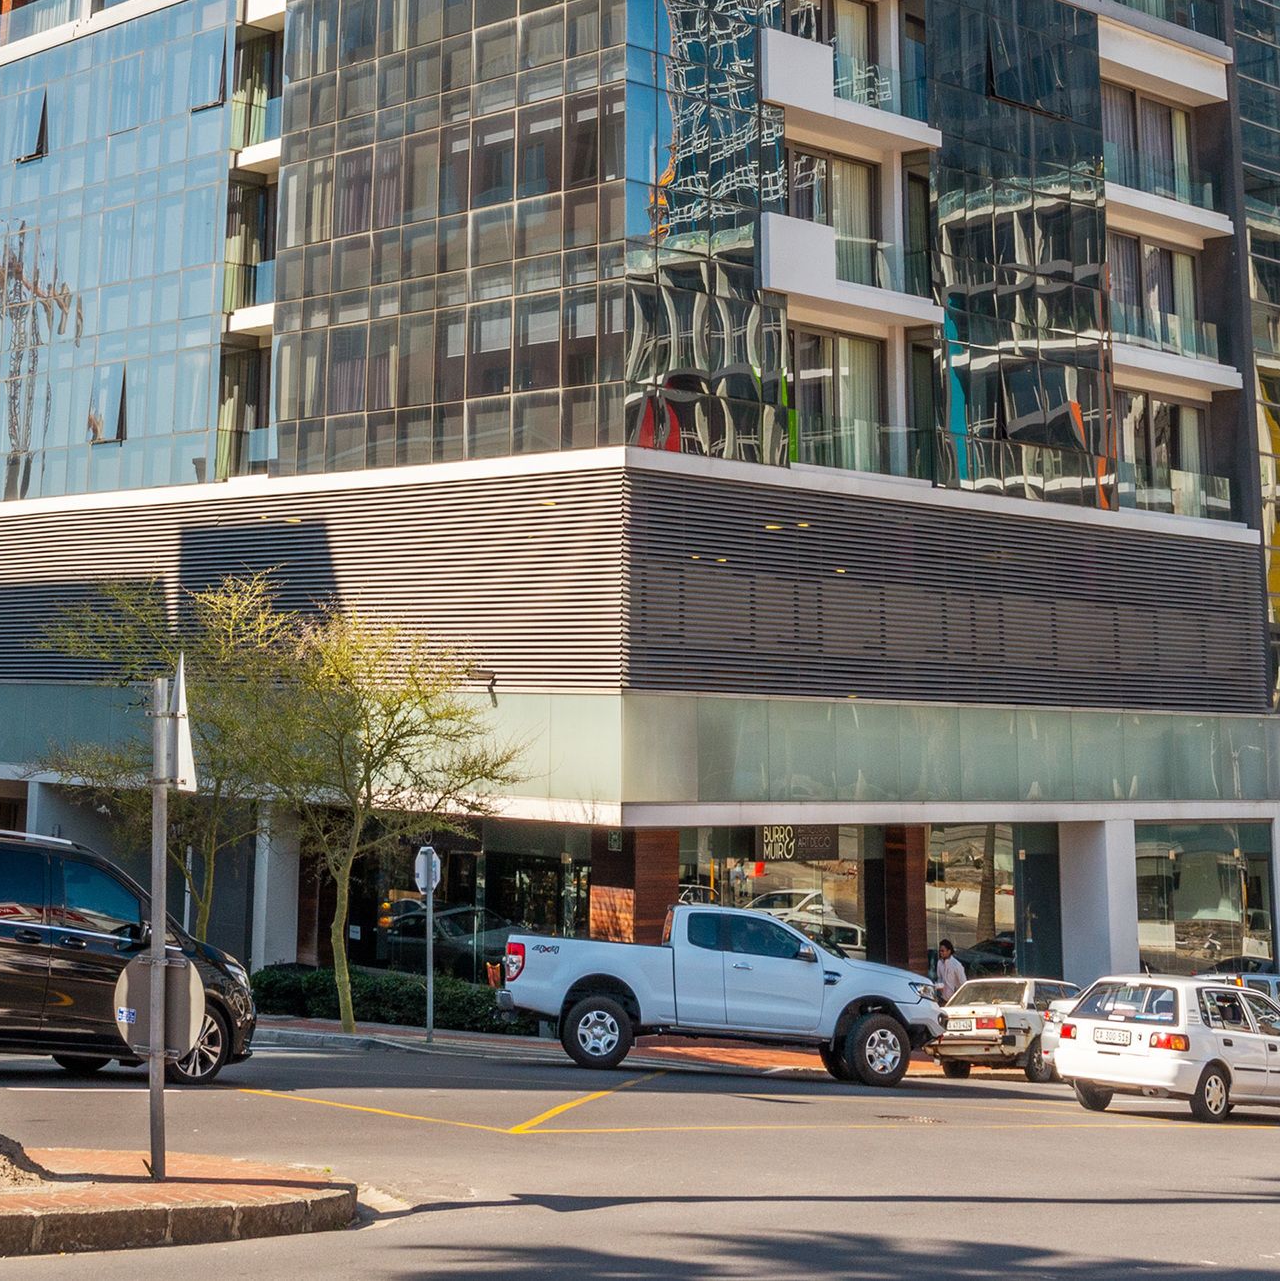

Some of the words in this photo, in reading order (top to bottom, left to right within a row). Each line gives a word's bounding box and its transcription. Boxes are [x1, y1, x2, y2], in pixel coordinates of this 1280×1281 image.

[763, 826, 785, 843] BURR
[784, 825, 796, 859] &
[763, 842, 784, 860] MUIR
[1095, 1030, 1104, 1039] CA
